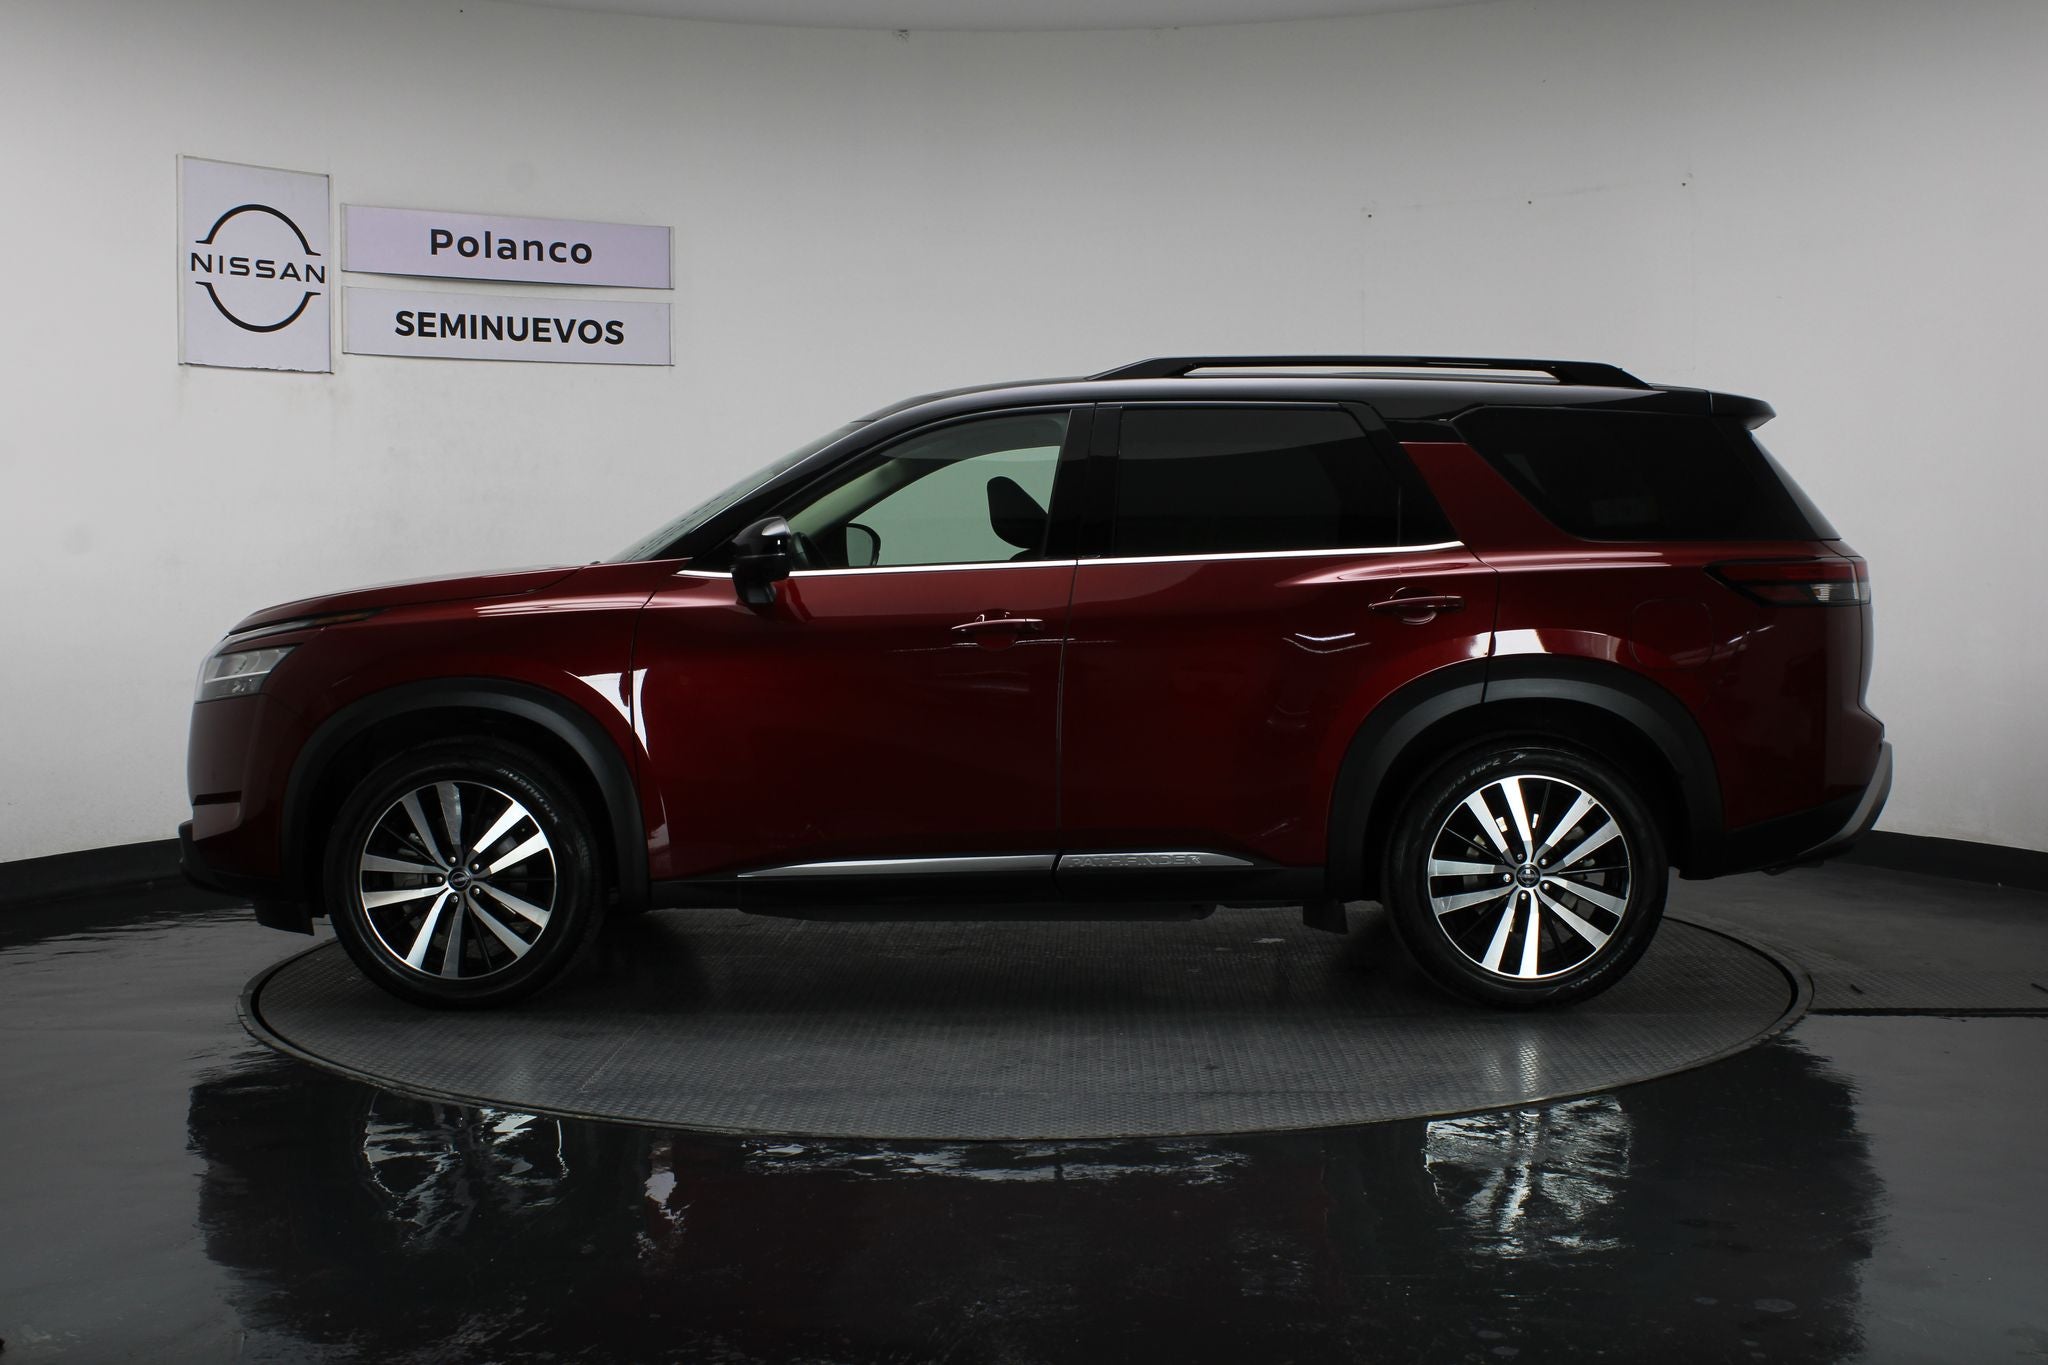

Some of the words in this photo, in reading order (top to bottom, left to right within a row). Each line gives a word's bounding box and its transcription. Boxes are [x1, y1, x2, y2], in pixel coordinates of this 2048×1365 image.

[430, 228, 593, 265] Polanco
[191, 252, 326, 284] NISSAN
[394, 310, 625, 346] SEMINUEVOS
